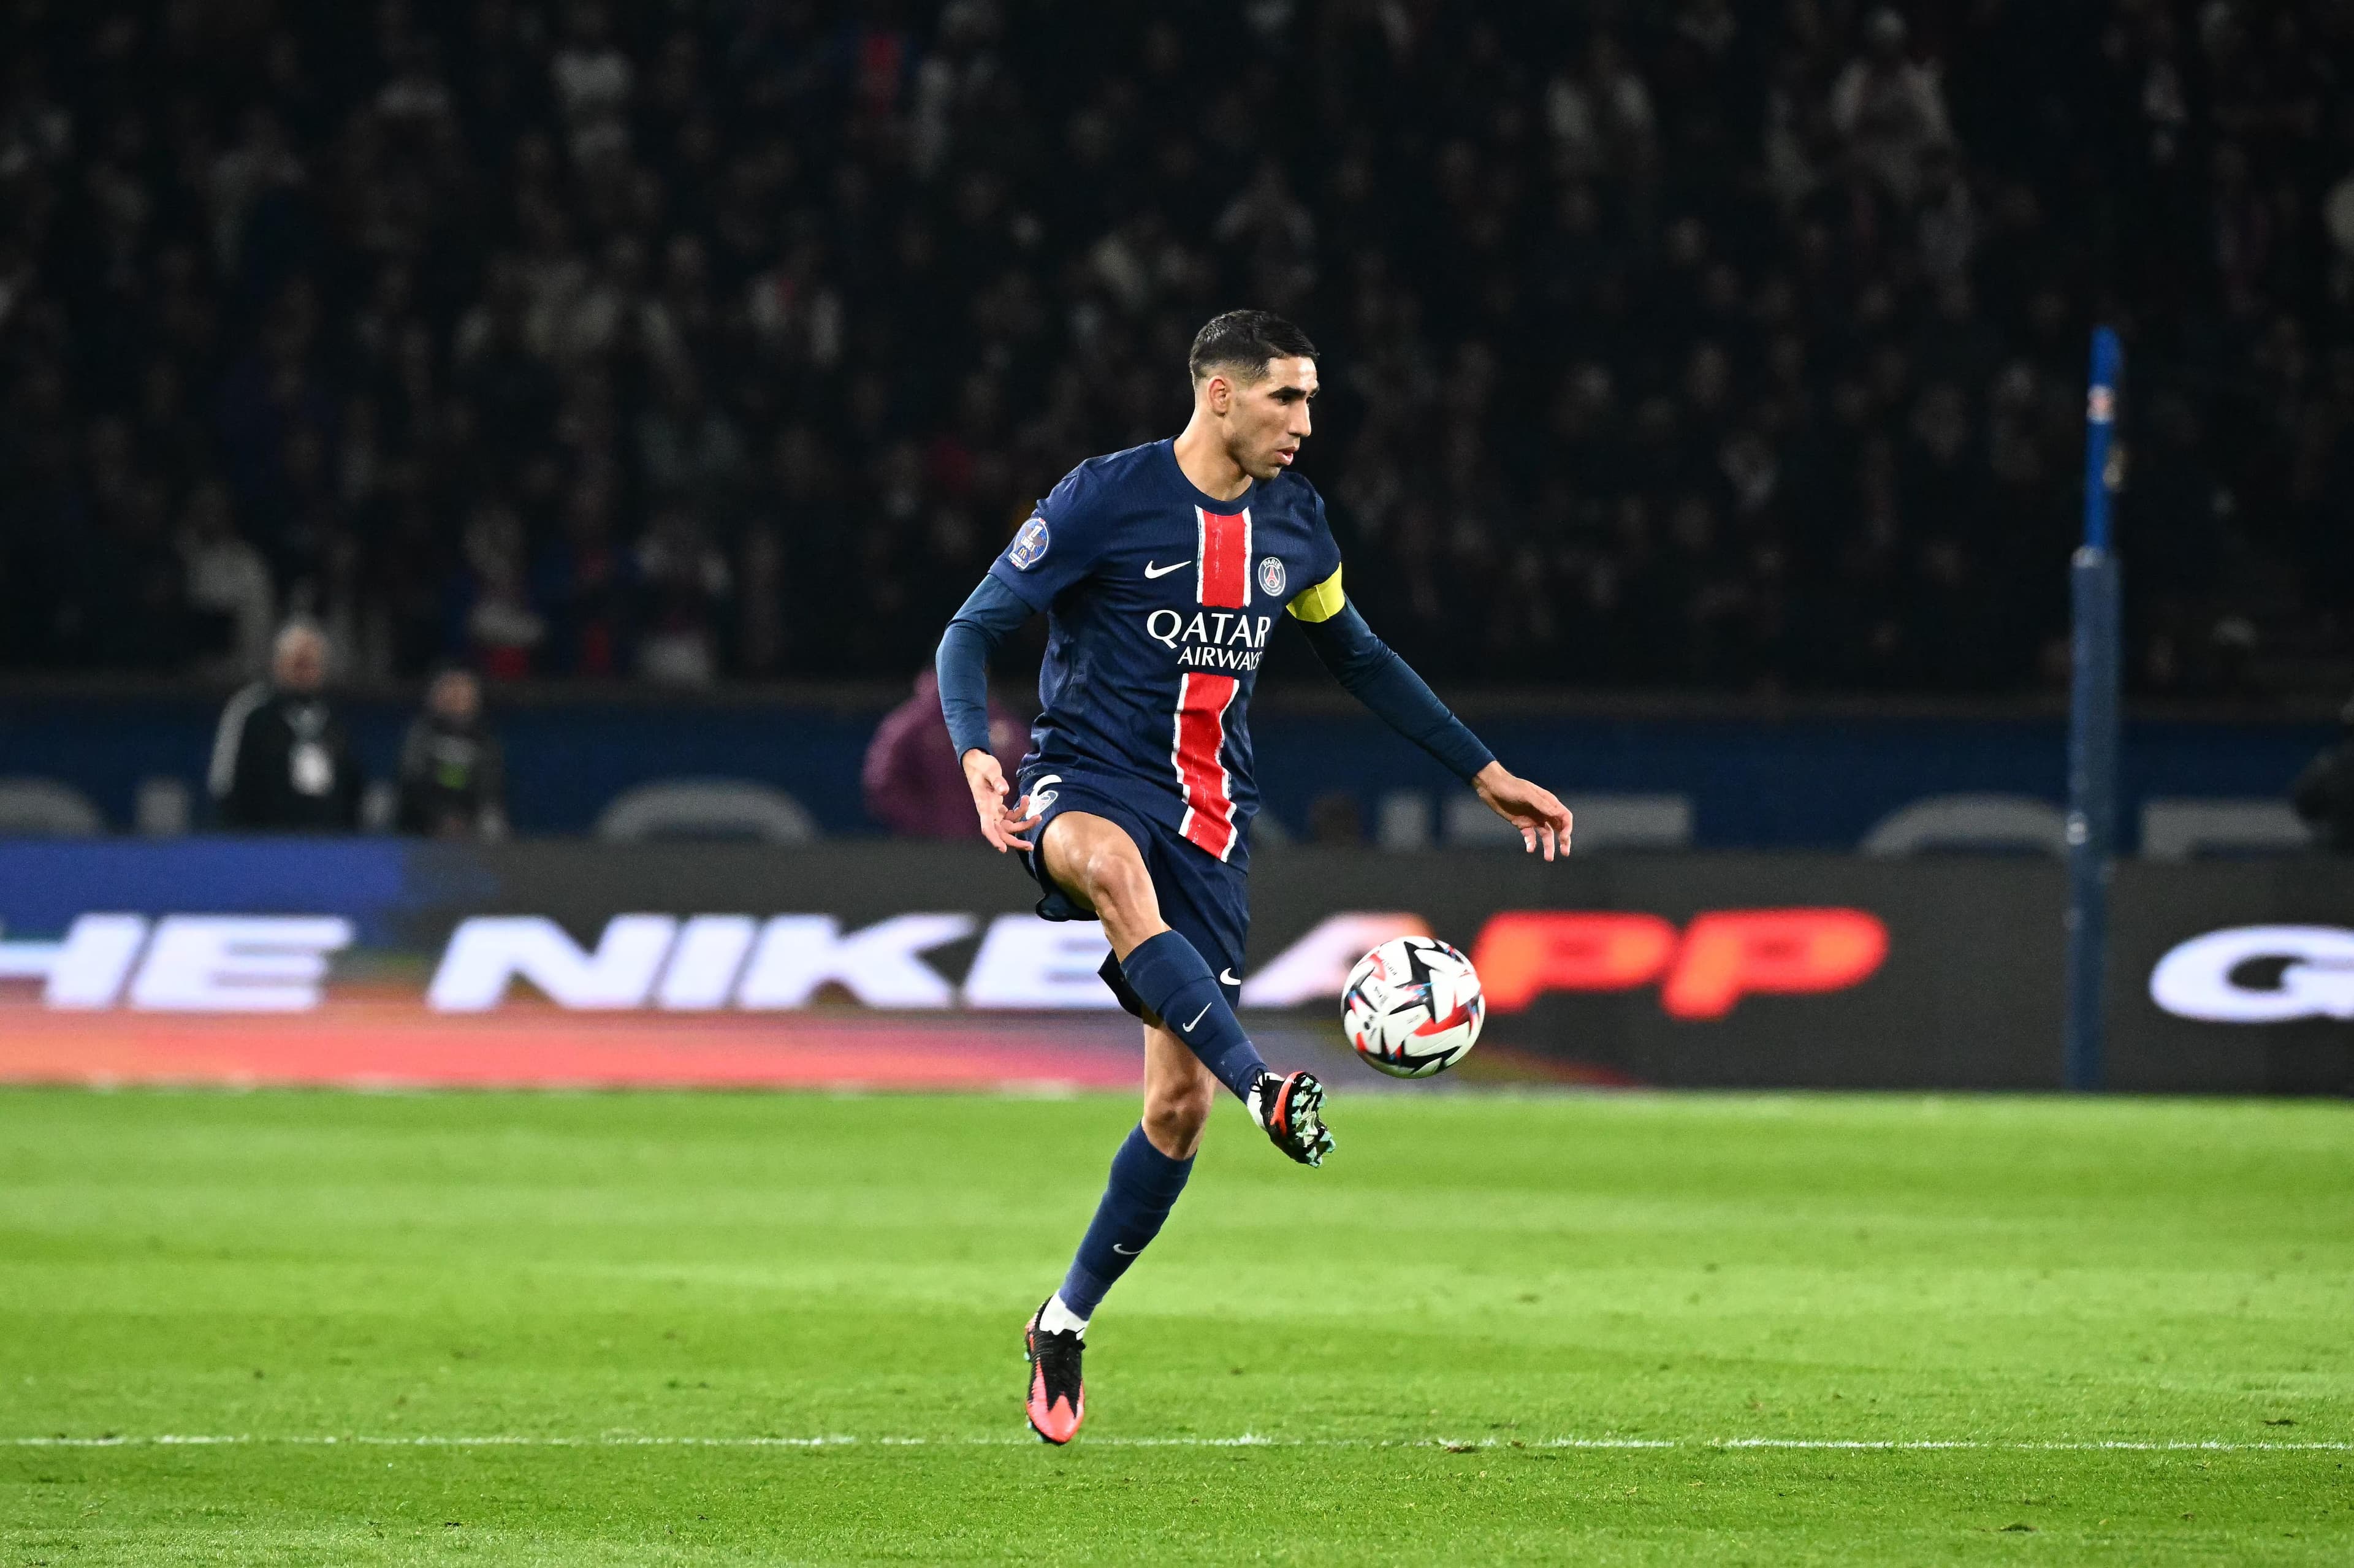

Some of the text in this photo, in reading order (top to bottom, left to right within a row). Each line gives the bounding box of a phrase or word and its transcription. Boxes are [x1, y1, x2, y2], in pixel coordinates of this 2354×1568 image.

[1263, 558, 1281, 569] PARIS
[1146, 609, 1271, 650] QATAR
[1177, 646, 1263, 671] AIRWAYS
[424, 911, 1134, 1012] NIKE
